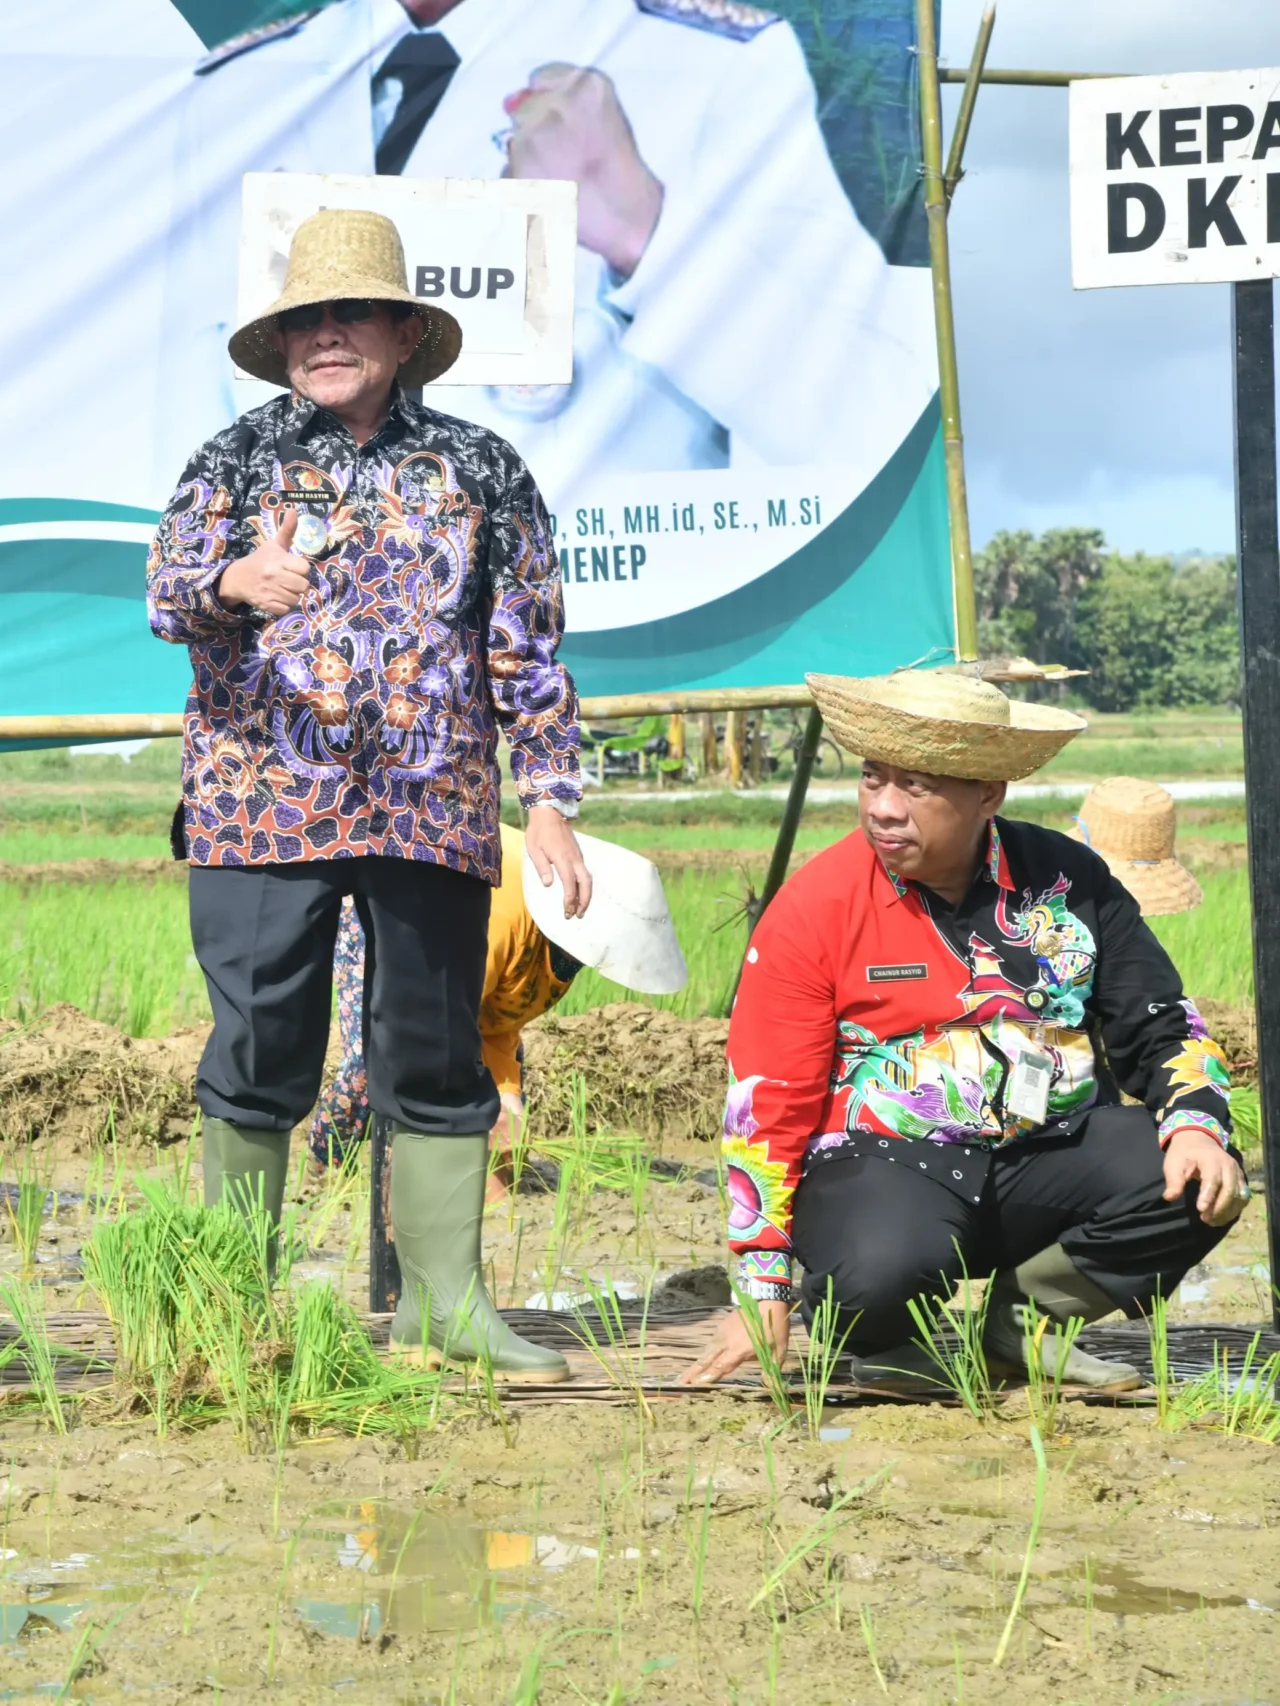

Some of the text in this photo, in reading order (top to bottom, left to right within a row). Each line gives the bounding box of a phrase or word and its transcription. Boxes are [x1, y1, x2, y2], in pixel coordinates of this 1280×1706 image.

[1107, 172, 1280, 254] DK
[576, 507, 614, 540] SH,
[767, 495, 821, 527] M.Si
